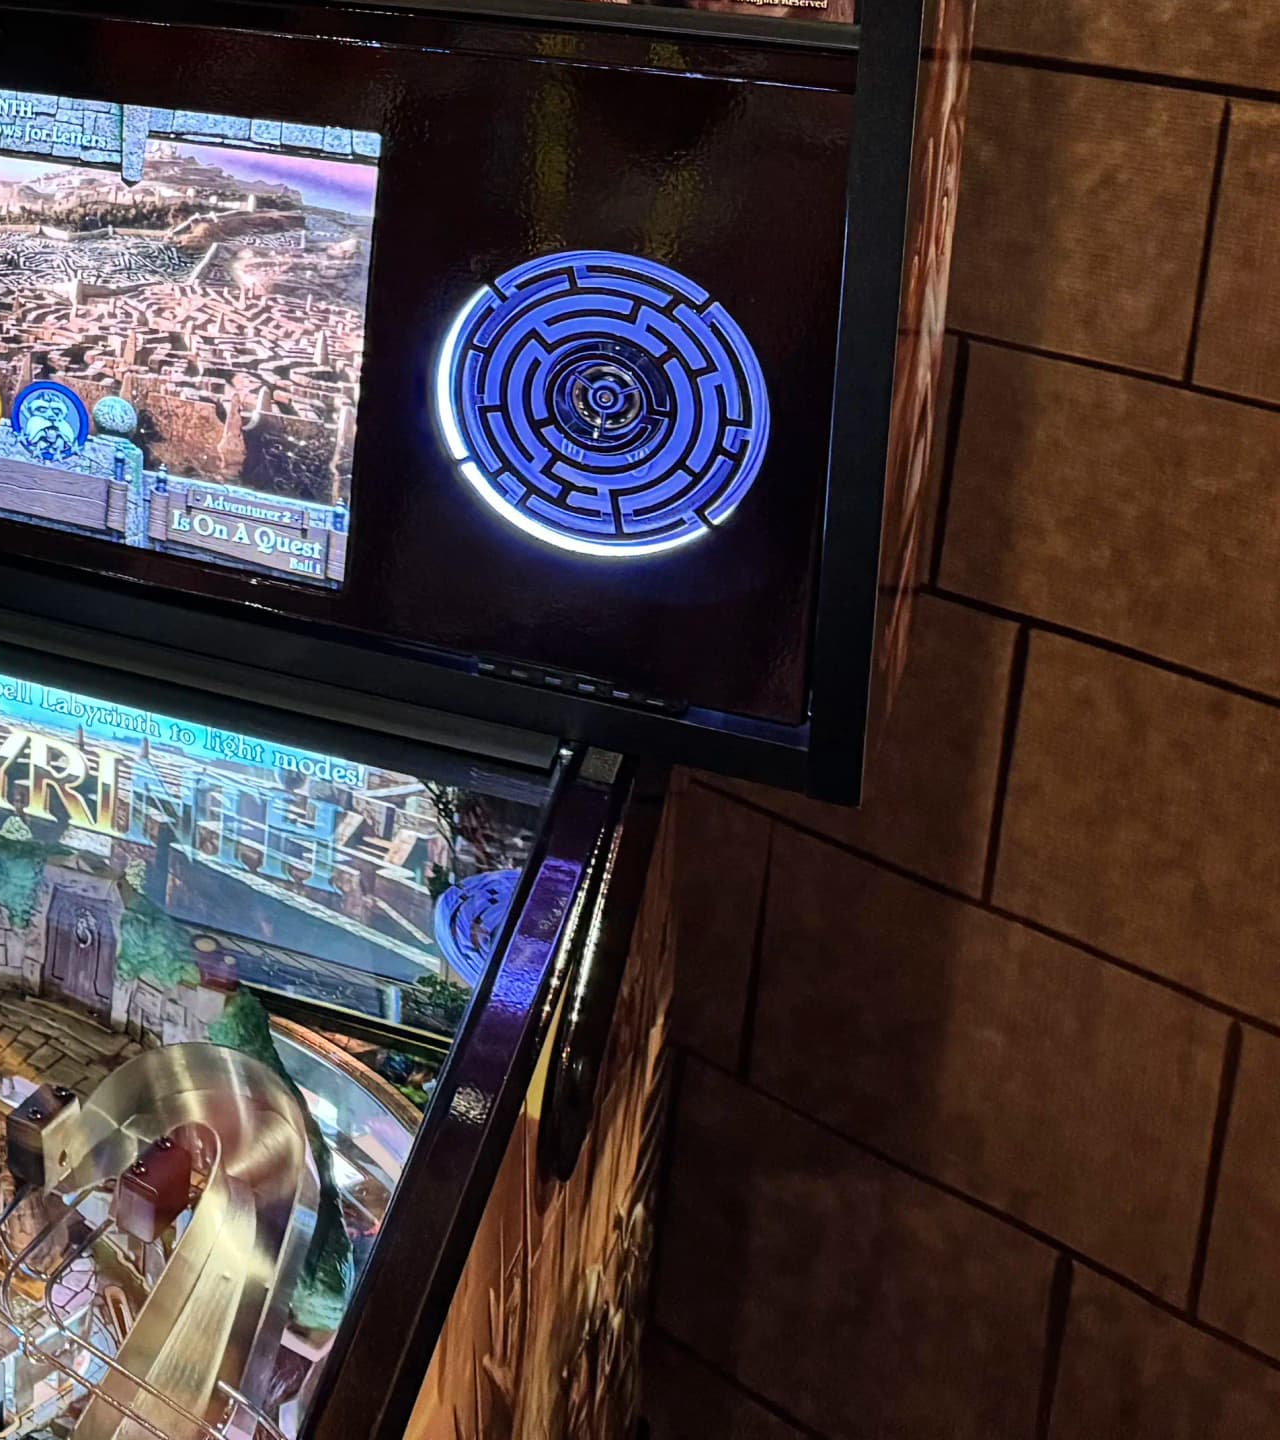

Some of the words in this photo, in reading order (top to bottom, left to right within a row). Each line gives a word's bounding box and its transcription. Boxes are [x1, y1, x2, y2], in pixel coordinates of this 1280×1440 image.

[25, 122, 50, 142] for
[204, 494, 282, 522] Adventurer
[280, 511, 290, 523] 2
[172, 509, 190, 531] Is
[193, 514, 228, 540] On
[232, 522, 251, 544] A
[254, 527, 323, 559] Quest
[289, 557, 313, 572] Ball
[39, 686, 161, 737] Labyrinth
[170, 723, 197, 747] to
[203, 727, 265, 762] light
[272, 748, 366, 787] modes!
